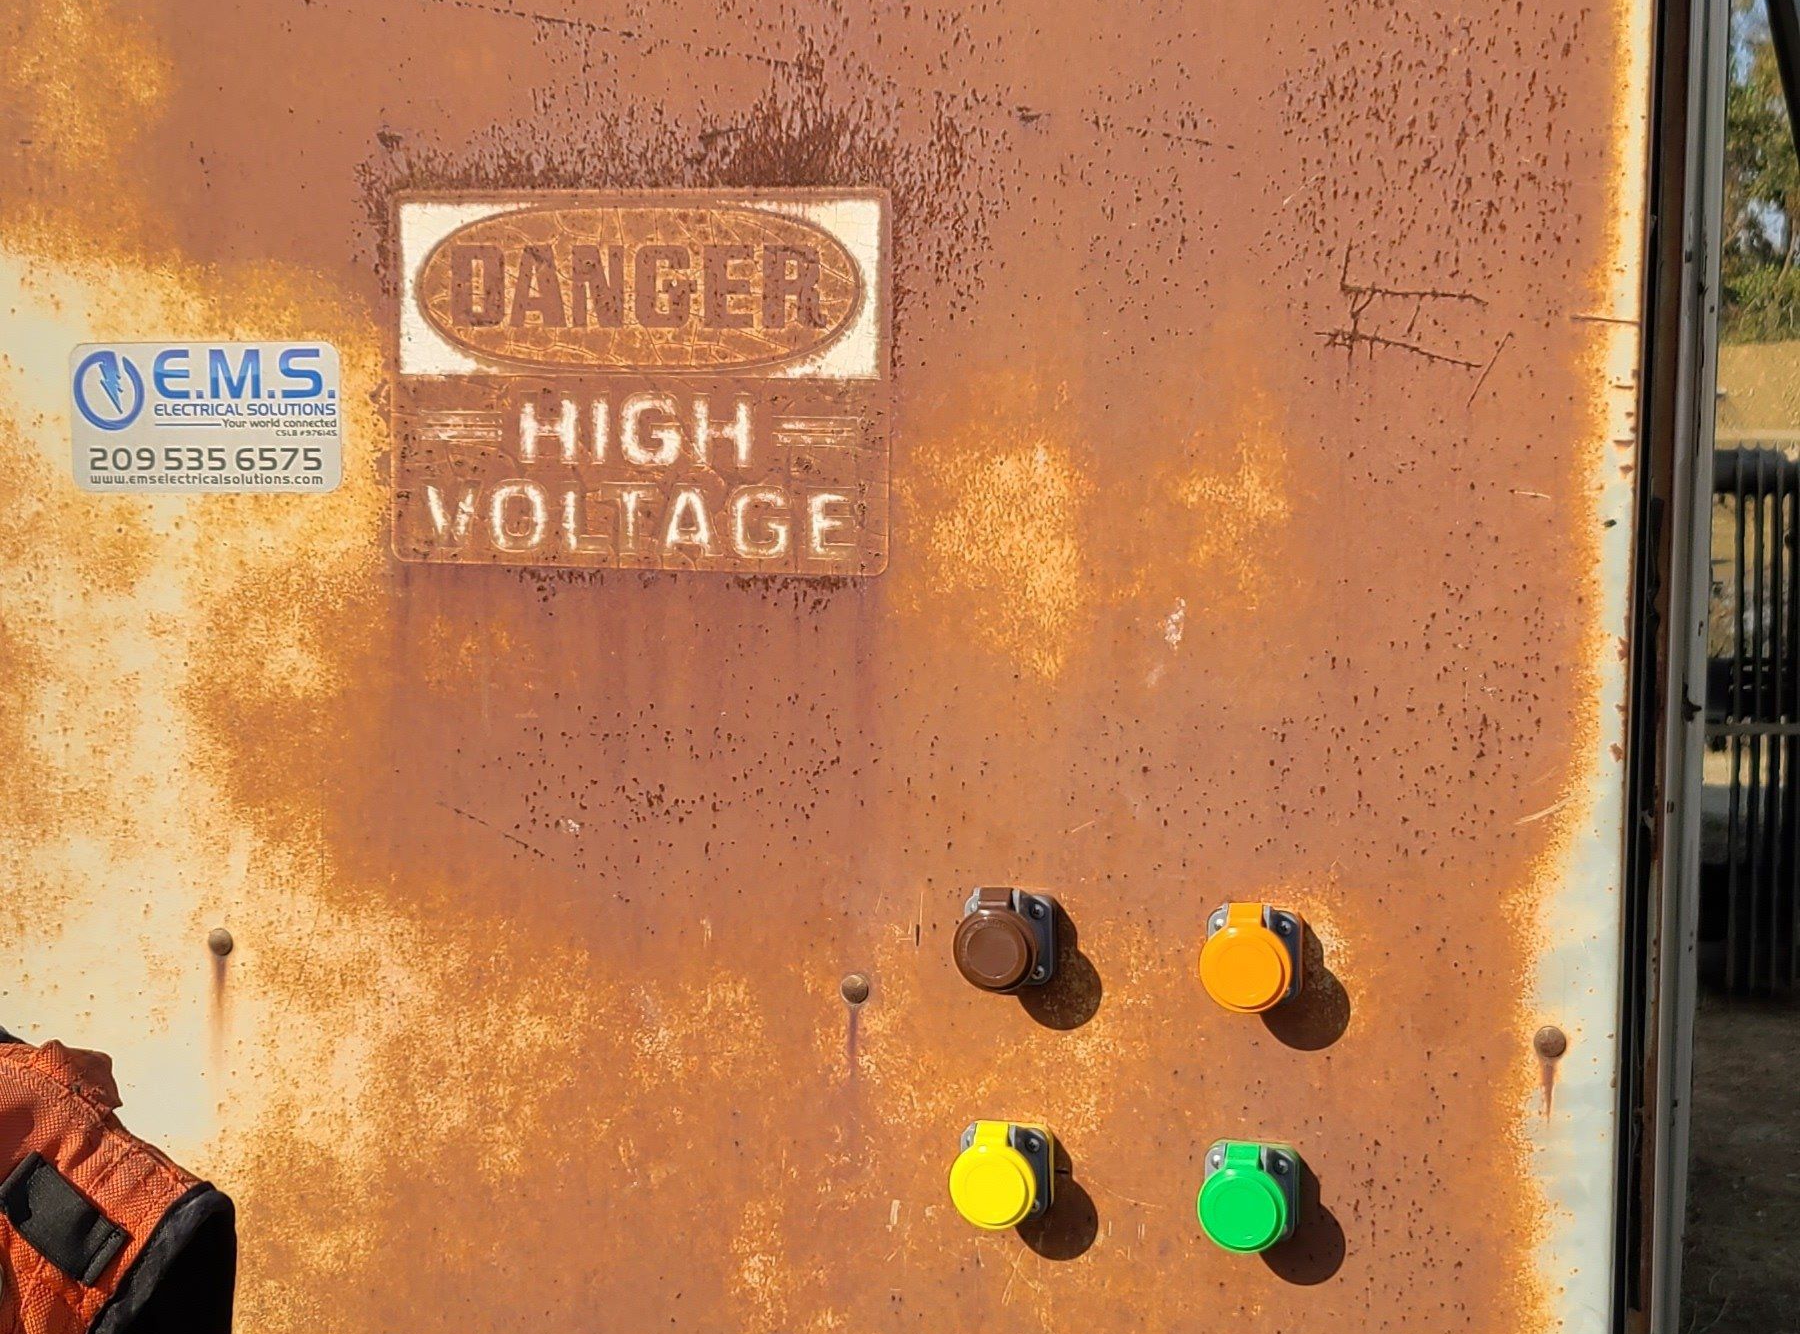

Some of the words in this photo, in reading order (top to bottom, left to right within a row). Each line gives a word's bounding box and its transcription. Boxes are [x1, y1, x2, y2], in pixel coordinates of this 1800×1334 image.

[450, 244, 827, 329] DANGER
[153, 348, 337, 400] E.M.S.
[154, 403, 244, 417] ELECTRICAL
[246, 403, 336, 417] SOLUTIONS
[221, 418, 247, 428] Your
[250, 418, 280, 428] world
[283, 418, 337, 428] connected
[275, 429, 298, 437] CSLB
[518, 391, 754, 467] HIGH
[89, 447, 156, 471] 209
[164, 447, 227, 471] 535
[235, 447, 323, 471] 6575
[90, 473, 324, 485] www.emselectricalsolutions.com
[420, 478, 858, 560] VOLTAGE
